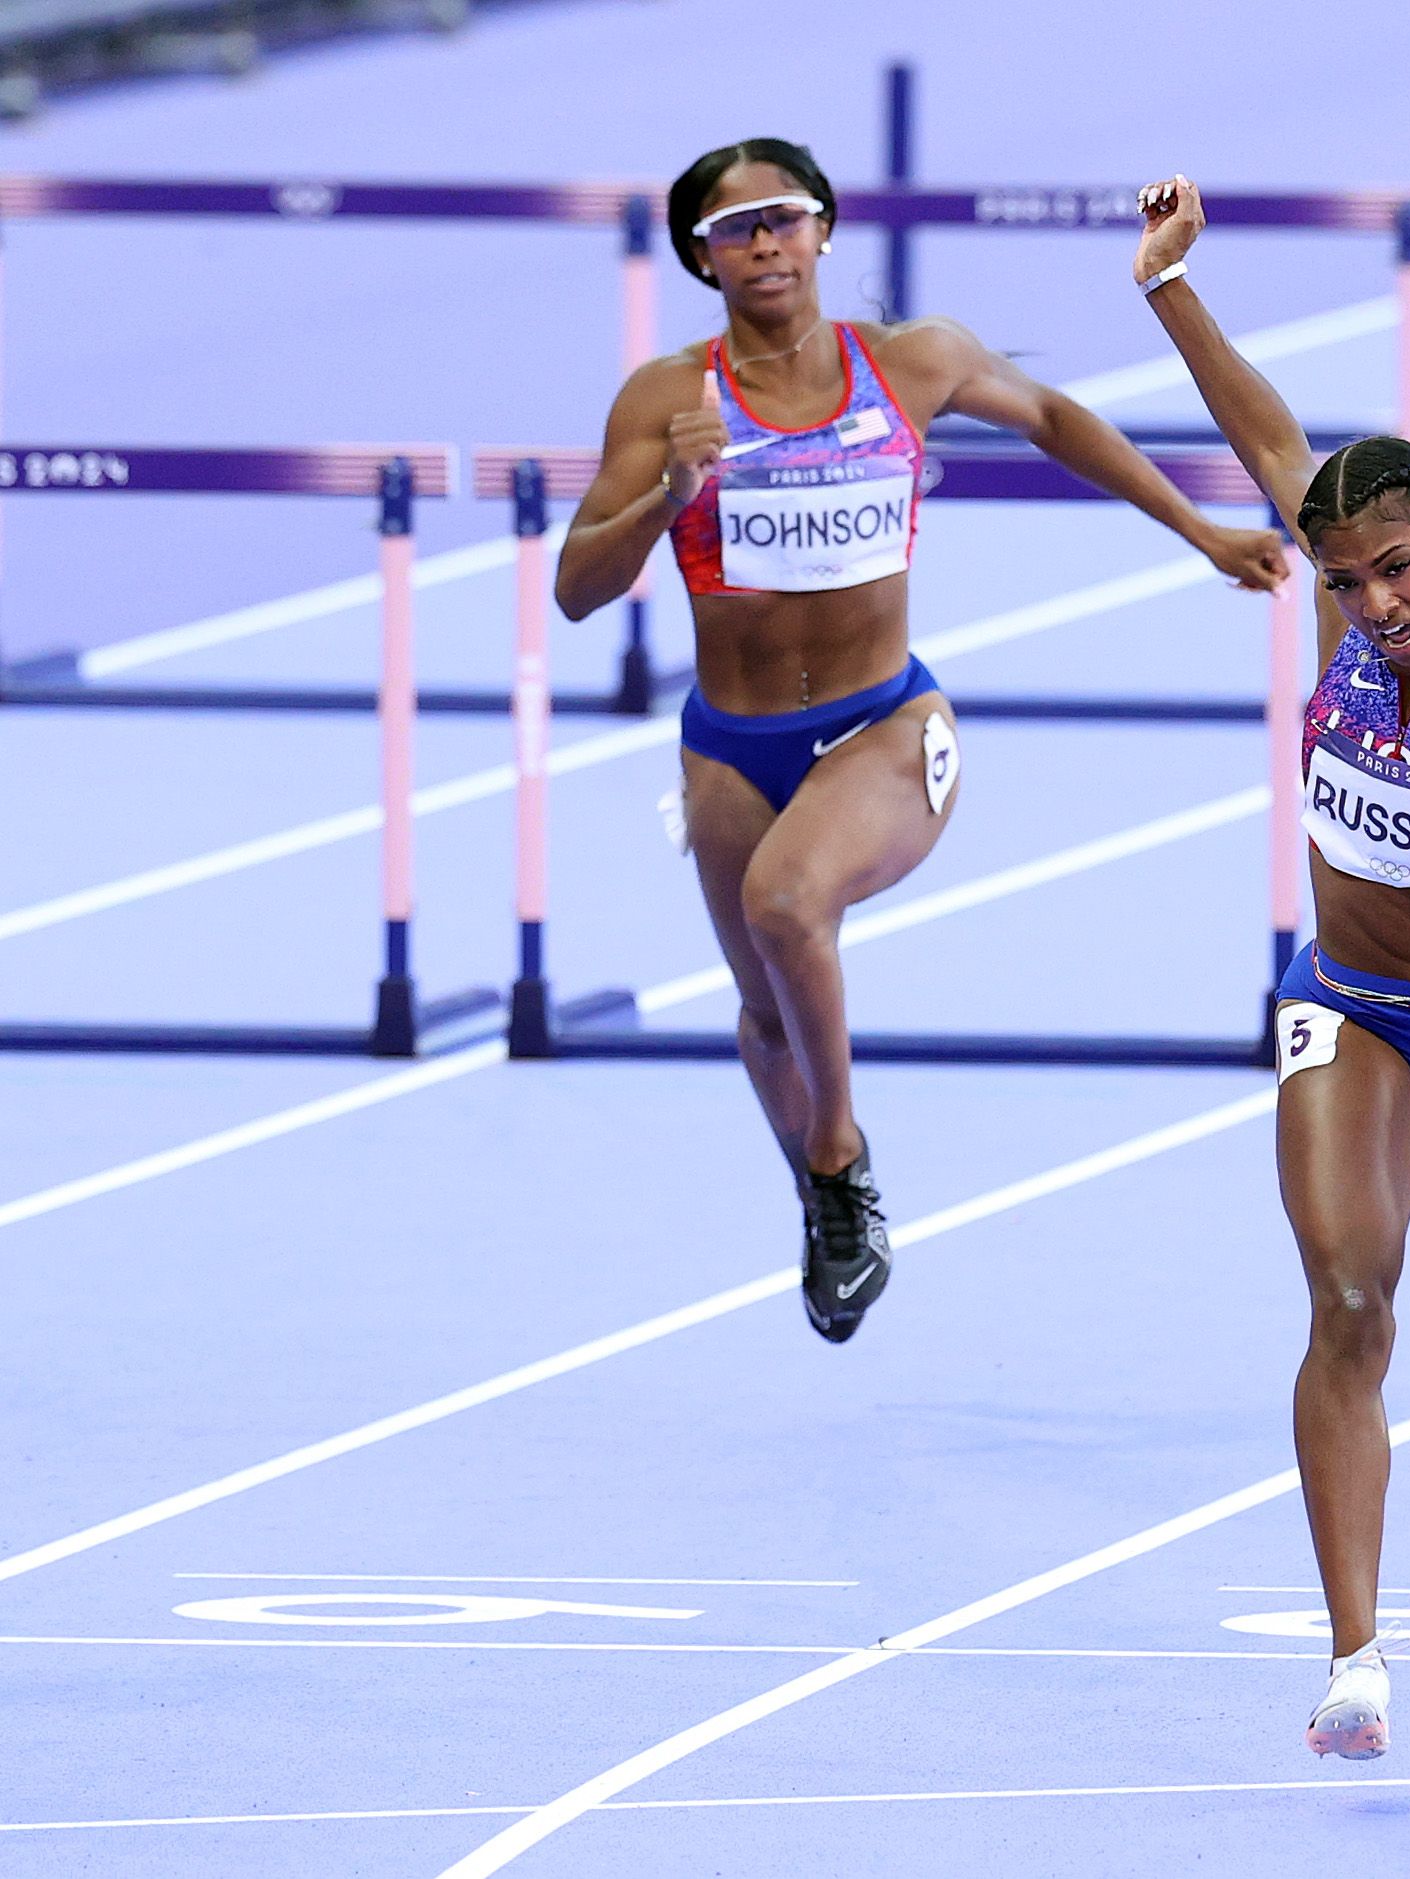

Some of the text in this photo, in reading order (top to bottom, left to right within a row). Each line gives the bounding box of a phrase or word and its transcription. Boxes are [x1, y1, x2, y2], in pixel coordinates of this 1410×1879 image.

[728, 499, 904, 549] JOHNSON
[1357, 751, 1400, 778] PARIS
[1290, 1018, 1312, 1058] 5
